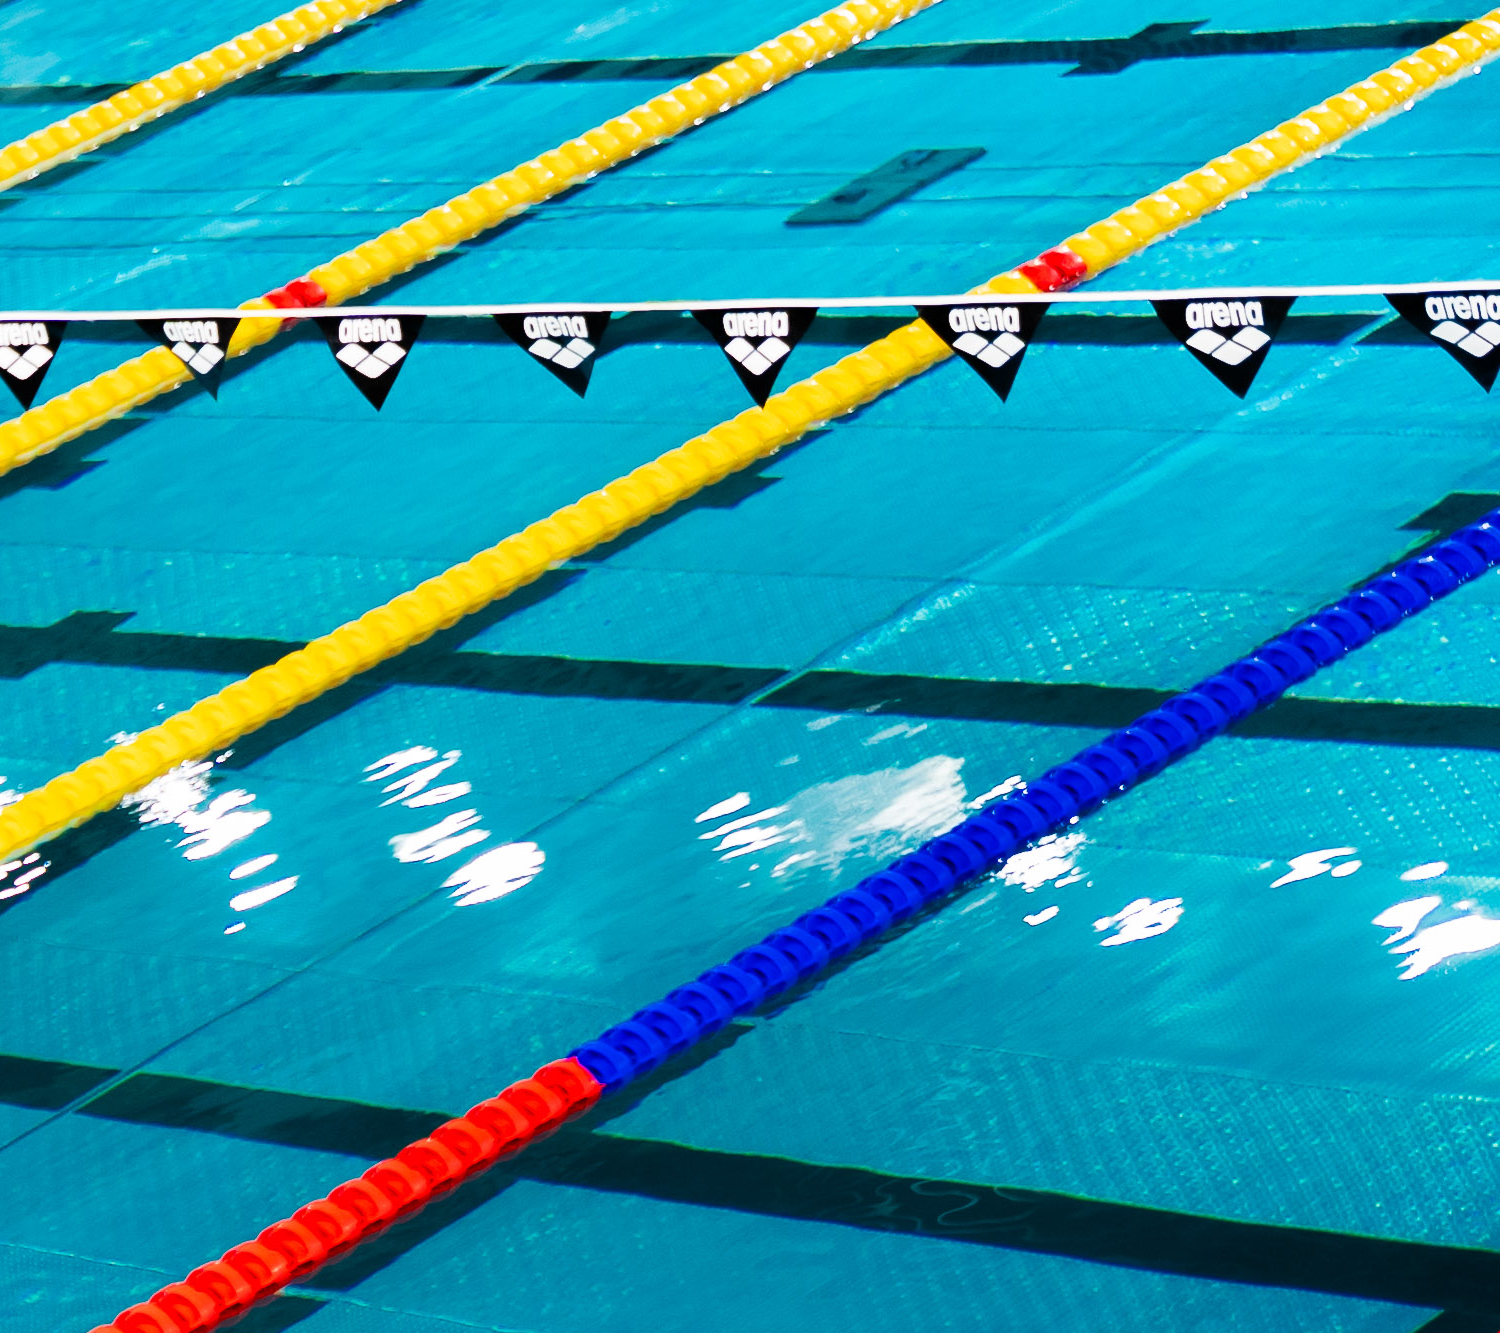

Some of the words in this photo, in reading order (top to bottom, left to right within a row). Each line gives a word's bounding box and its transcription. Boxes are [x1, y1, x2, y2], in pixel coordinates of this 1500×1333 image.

[523, 315, 589, 340] arena
[723, 312, 789, 337] arena
[949, 307, 1020, 334] arena
[1185, 301, 1264, 329] arena
[163, 318, 219, 344] arena
[338, 317, 404, 343] arena
